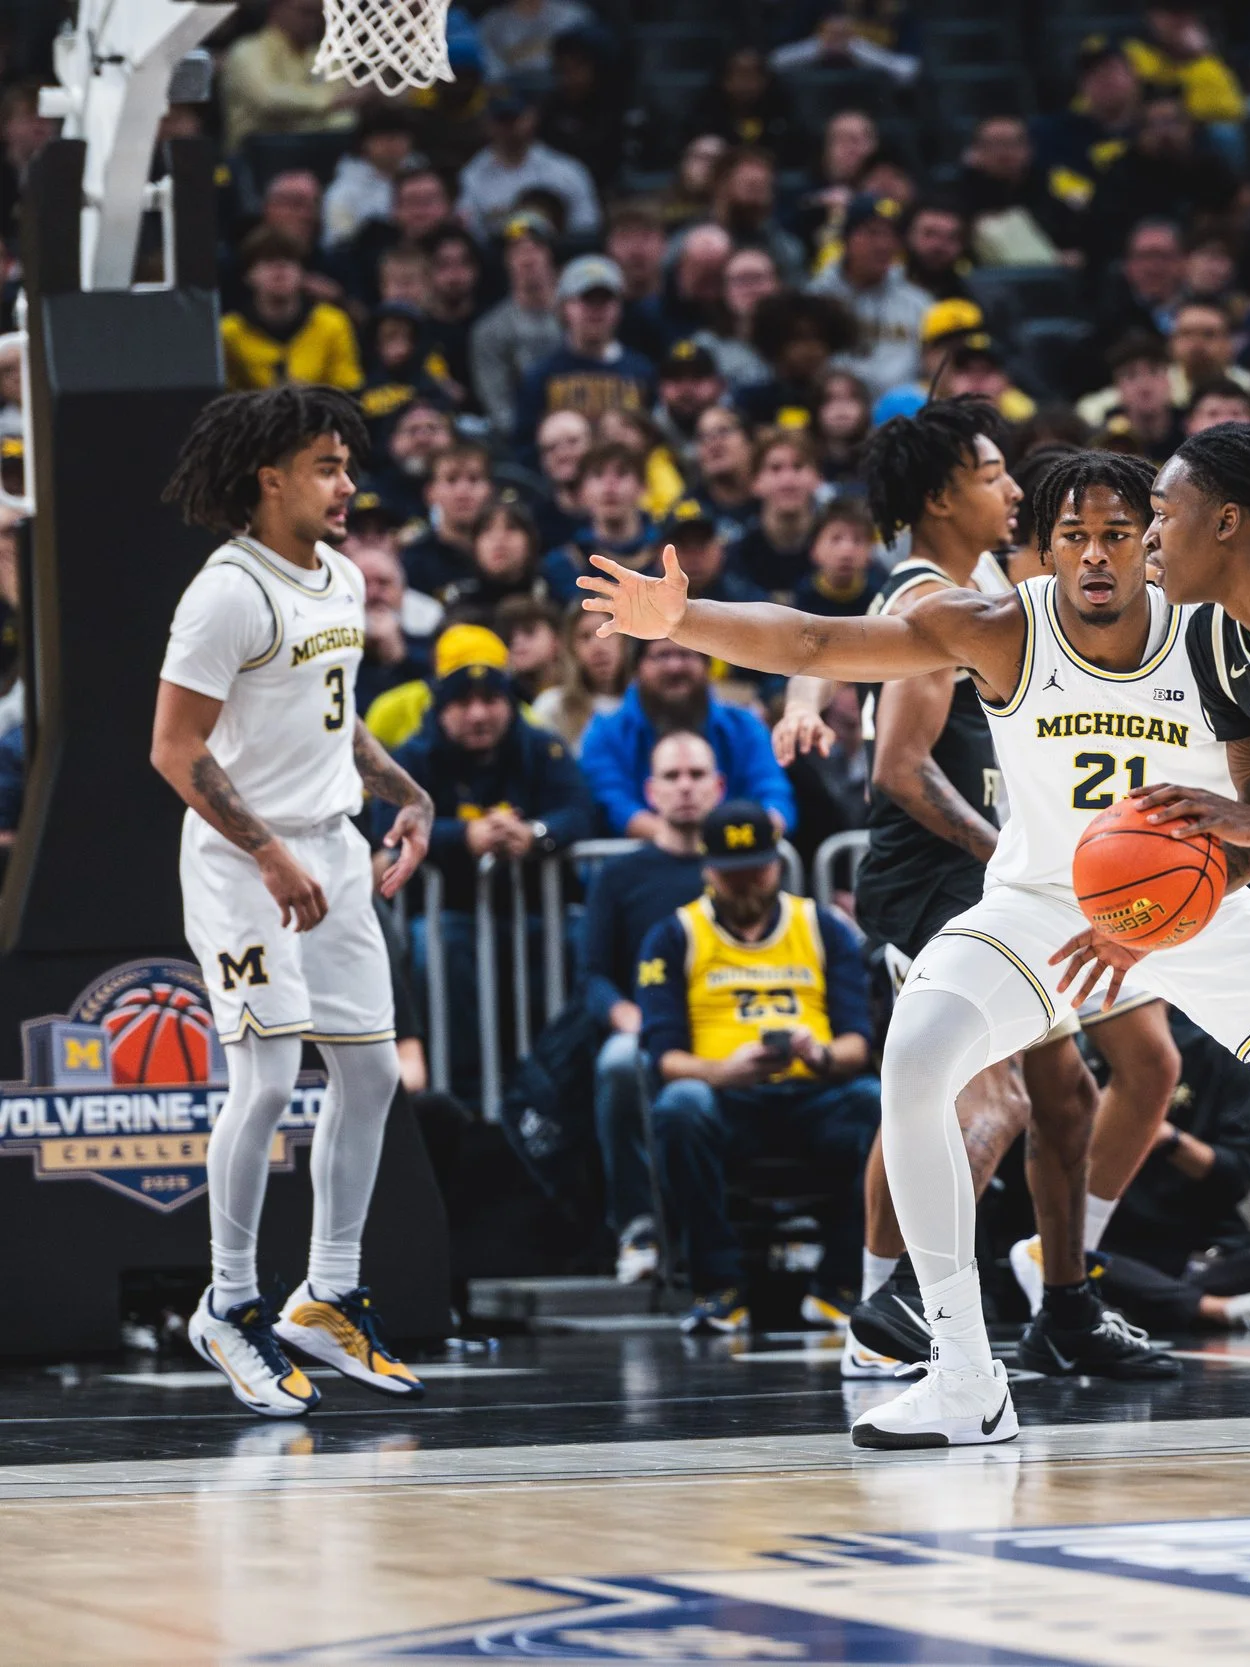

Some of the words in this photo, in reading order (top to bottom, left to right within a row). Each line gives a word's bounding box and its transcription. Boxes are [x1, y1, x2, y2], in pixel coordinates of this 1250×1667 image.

[323, 664, 346, 733] 3
[1036, 712, 1189, 749] MICHIGAN
[1072, 752, 1147, 810] 21
[723, 823, 756, 850] M
[217, 944, 270, 991] M
[64, 1037, 102, 1070] M
[62, 1140, 209, 1162] CHALLE
